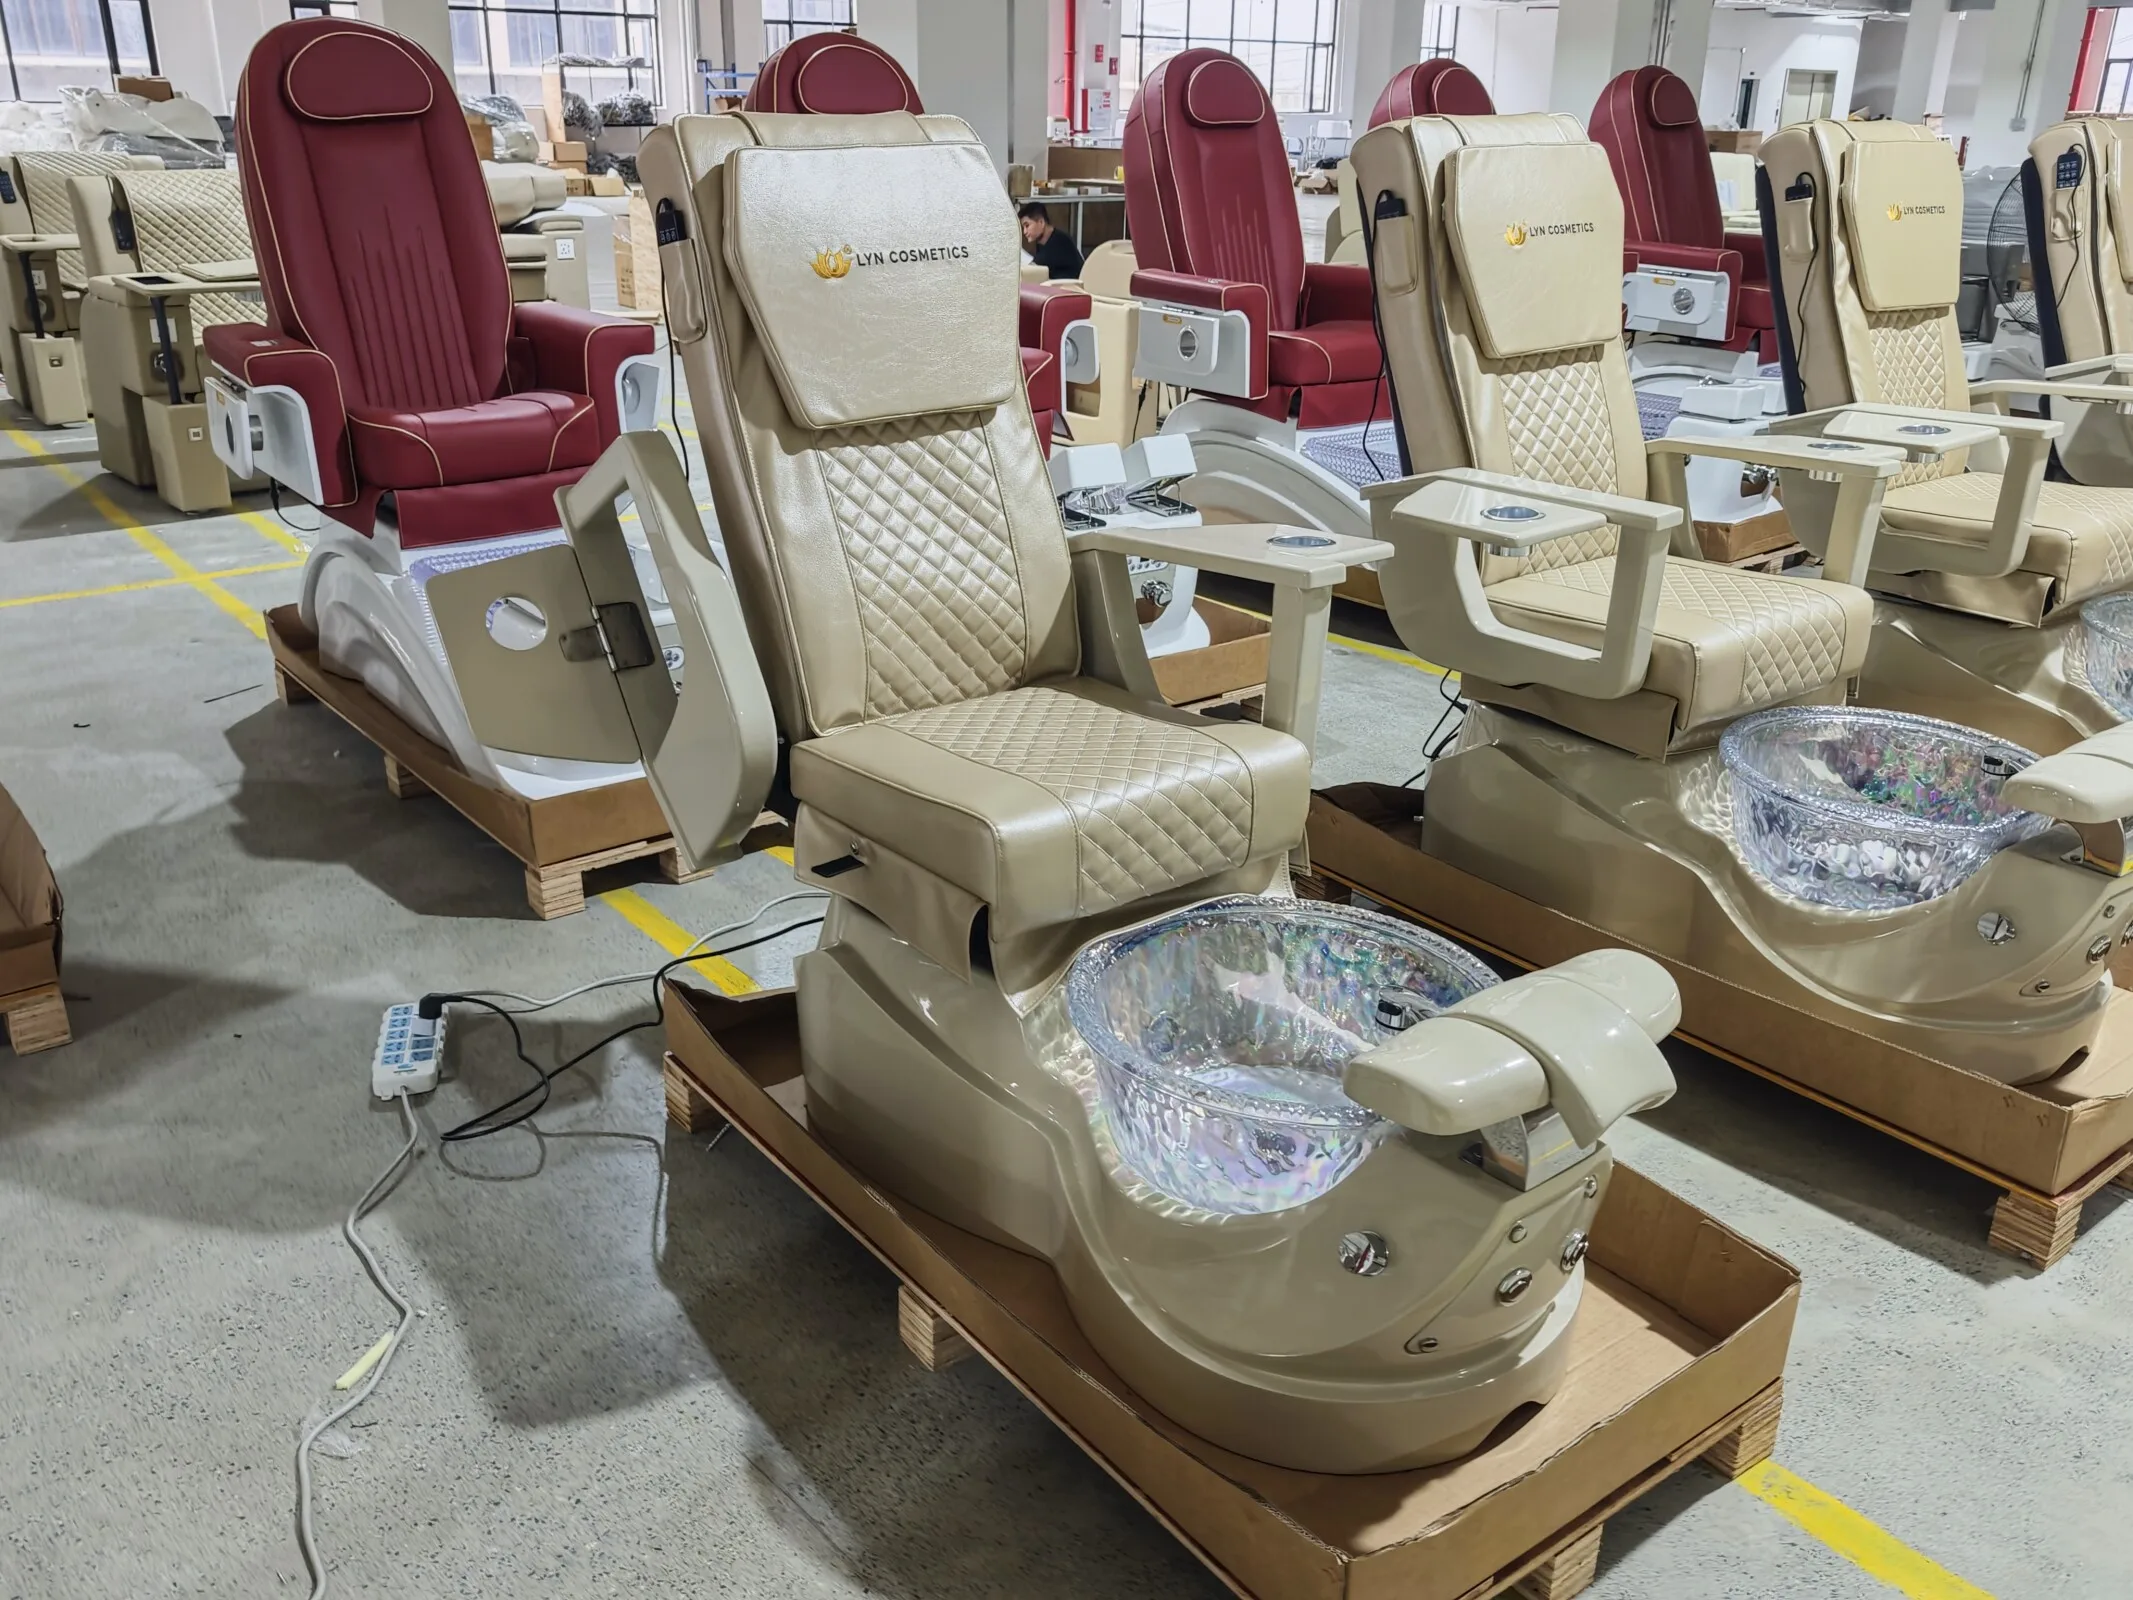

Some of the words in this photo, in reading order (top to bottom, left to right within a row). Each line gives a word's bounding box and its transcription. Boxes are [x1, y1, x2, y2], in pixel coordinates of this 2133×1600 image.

[1529, 226, 1546, 237] LYN
[1547, 222, 1595, 235] COSMETICS
[856, 252, 884, 266] LYN
[889, 246, 969, 264] COSMETICS
